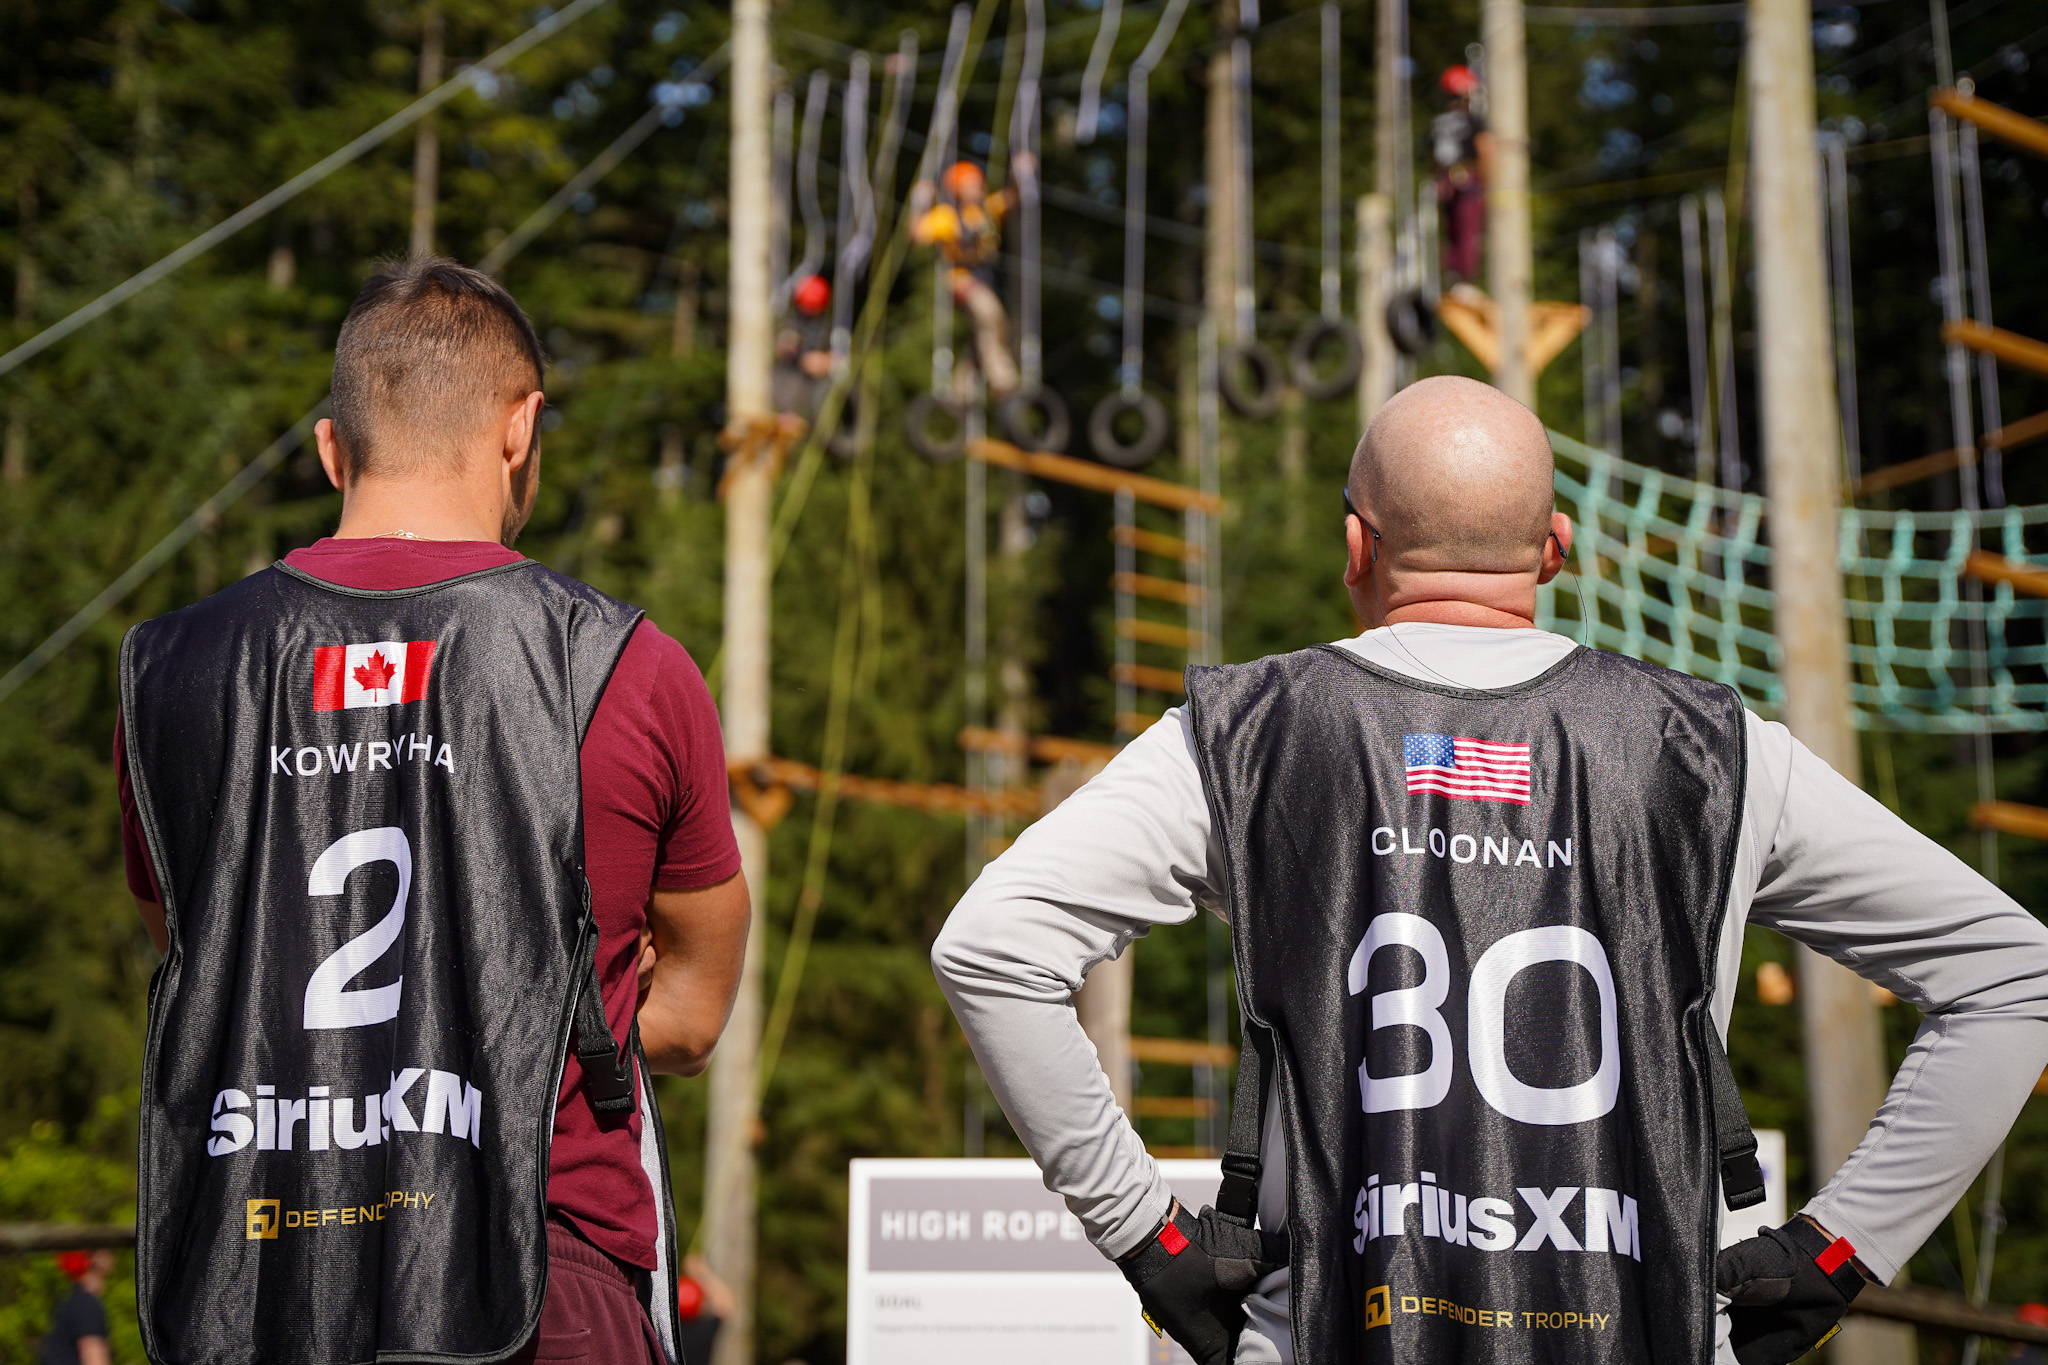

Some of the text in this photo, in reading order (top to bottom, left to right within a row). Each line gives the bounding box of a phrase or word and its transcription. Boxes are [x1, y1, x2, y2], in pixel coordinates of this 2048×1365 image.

[270, 732, 455, 777] KOWRYHA
[1371, 826, 1573, 868] CLOONAN
[303, 826, 412, 1030] 2
[1347, 912, 1621, 1126] 30
[285, 1190, 435, 1228] DEFEND OPHY
[881, 1209, 1084, 1241] HIGH ROPE
[1353, 1171, 1641, 1263] SiriusXM
[1400, 1295, 1610, 1330] DEFENDER TROPHY
